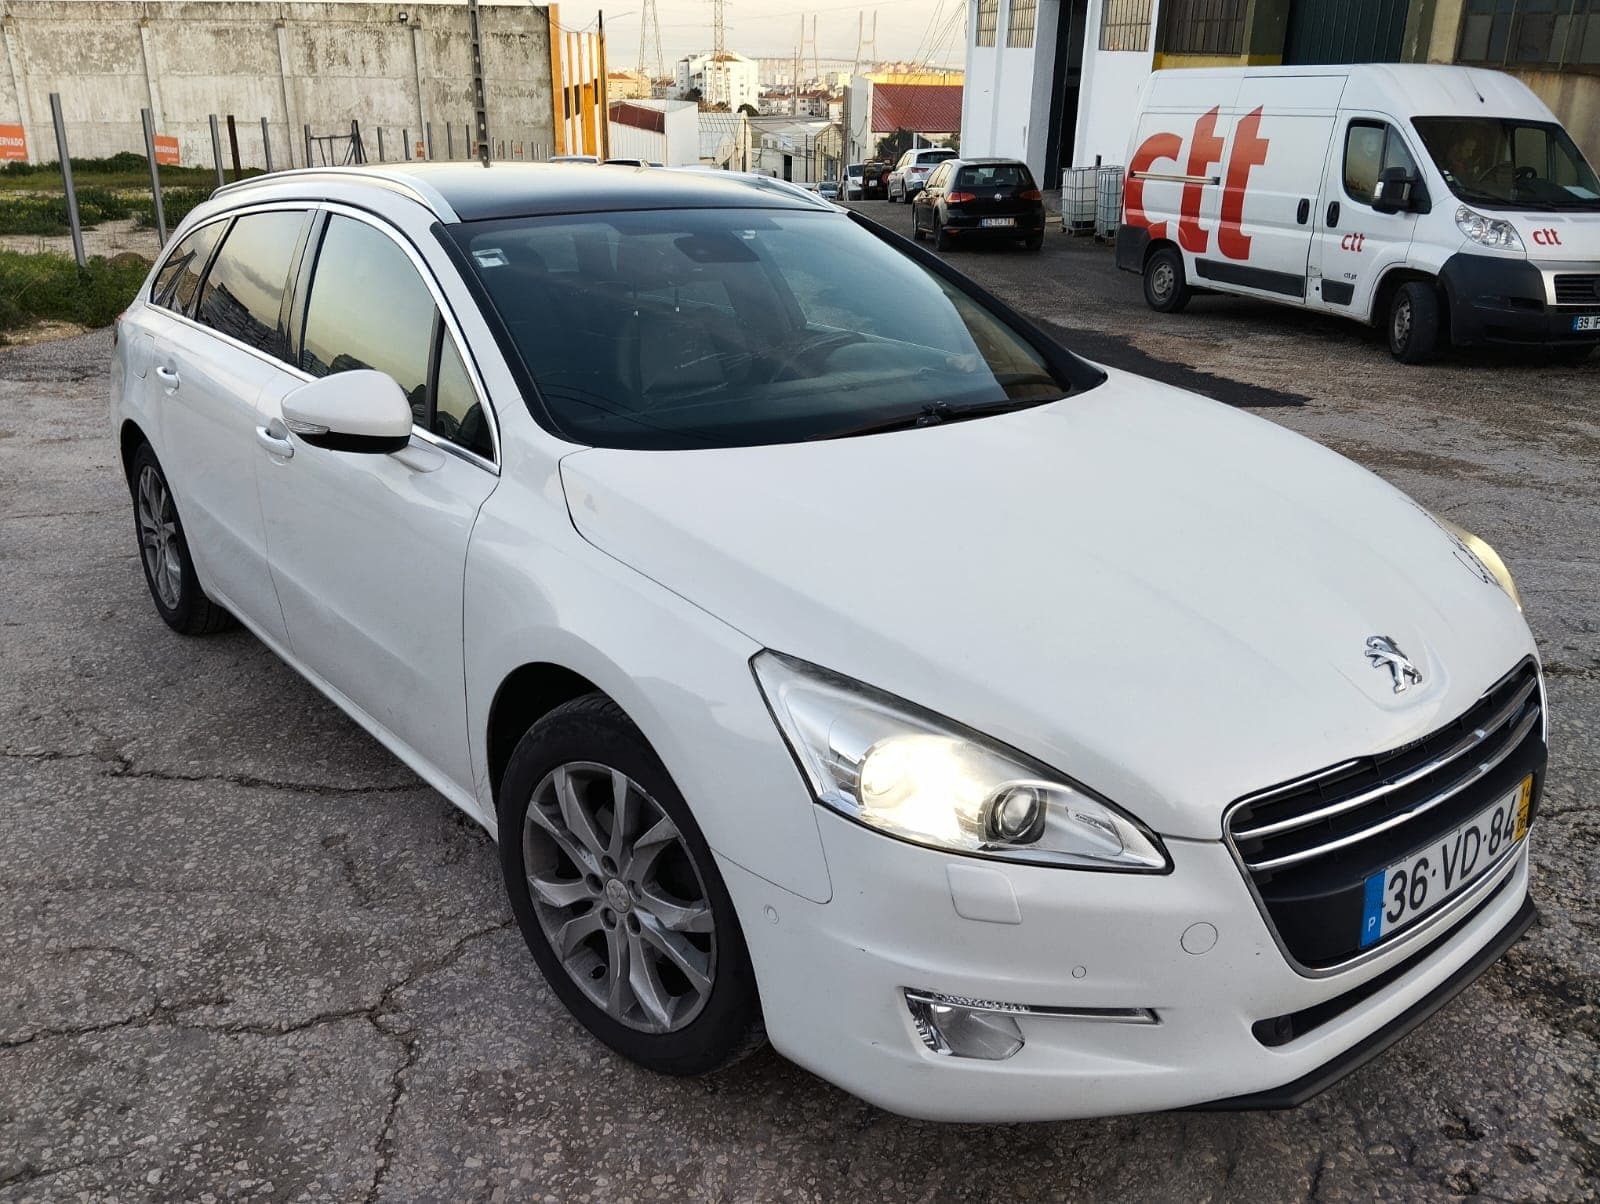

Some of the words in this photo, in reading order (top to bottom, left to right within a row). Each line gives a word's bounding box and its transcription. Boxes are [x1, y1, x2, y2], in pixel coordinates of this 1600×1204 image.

[1125, 104, 1270, 260] ctt
[1341, 232, 1366, 252] ctt
[1532, 228, 1562, 246] ctt
[1367, 916, 1376, 932] P
